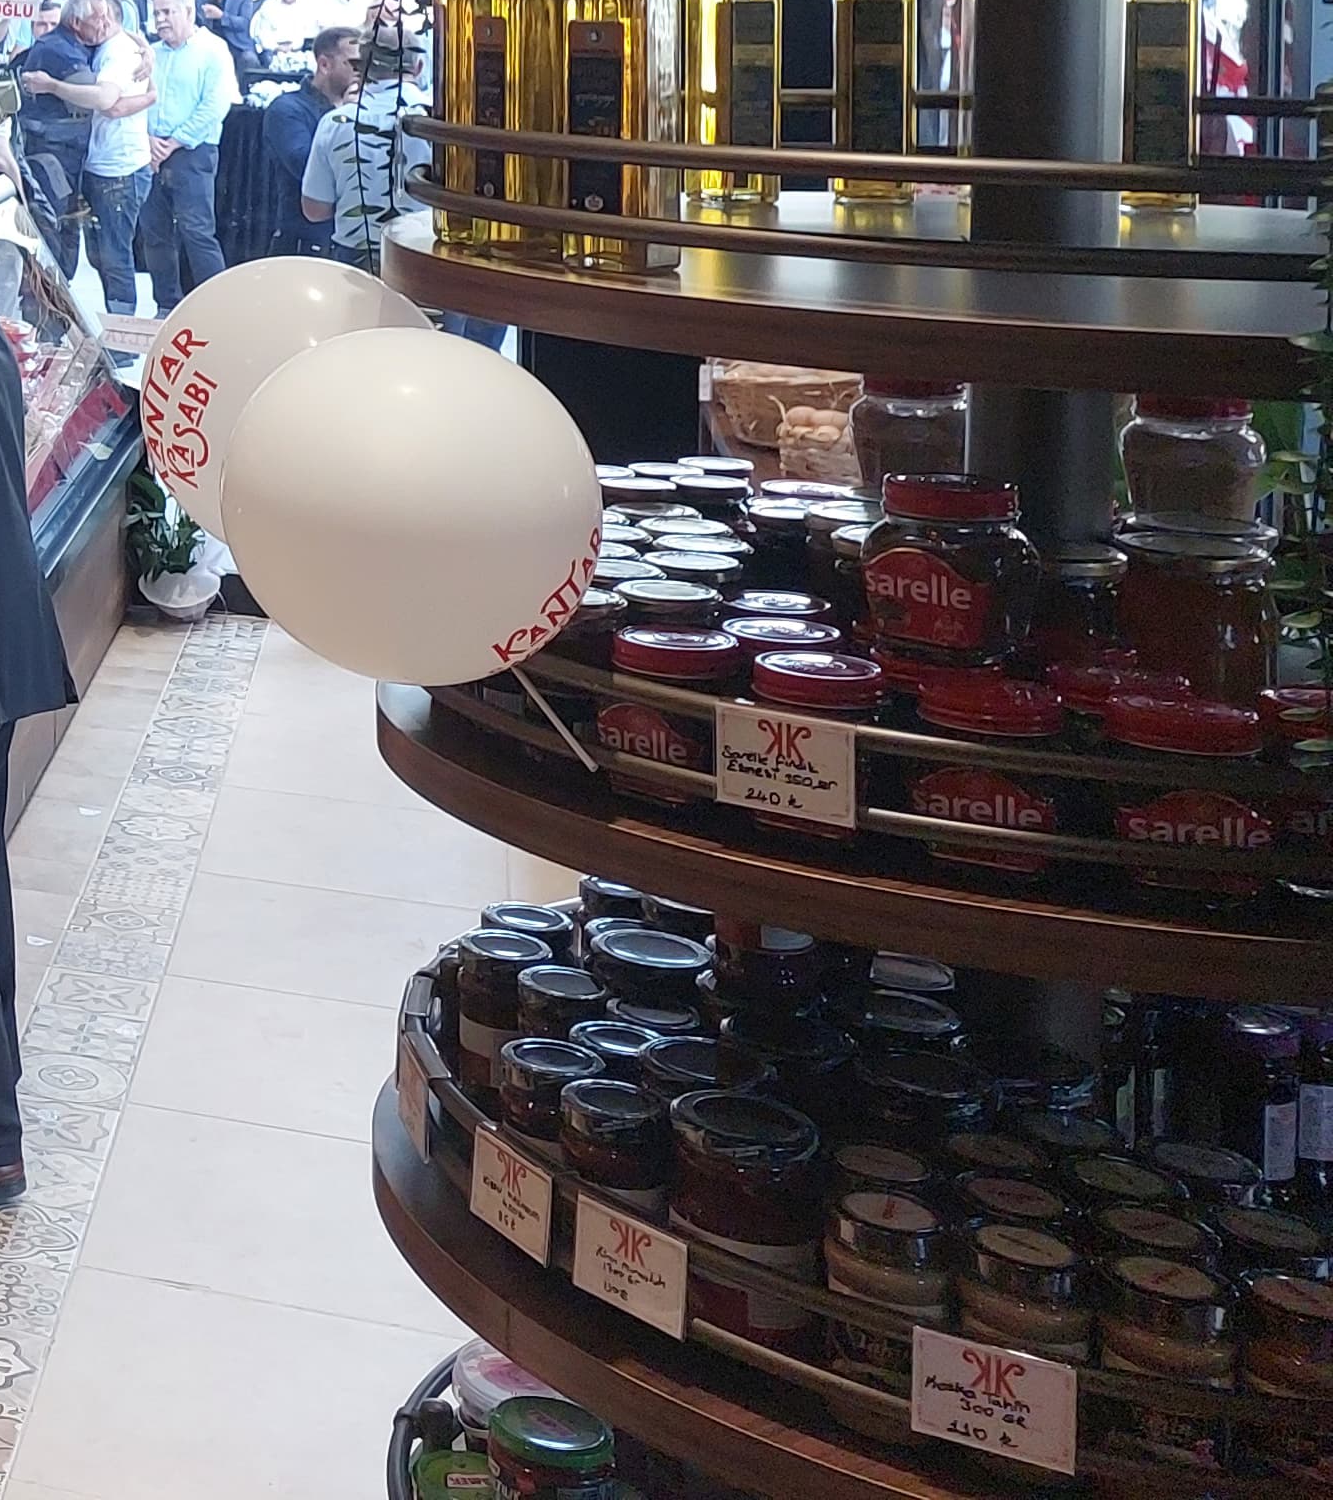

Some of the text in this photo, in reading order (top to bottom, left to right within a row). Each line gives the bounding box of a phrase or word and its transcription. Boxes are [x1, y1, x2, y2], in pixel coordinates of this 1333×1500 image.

[167, 370, 218, 490] KASABI
[744, 787, 781, 805] 240
[960, 1399, 994, 1417] 300
